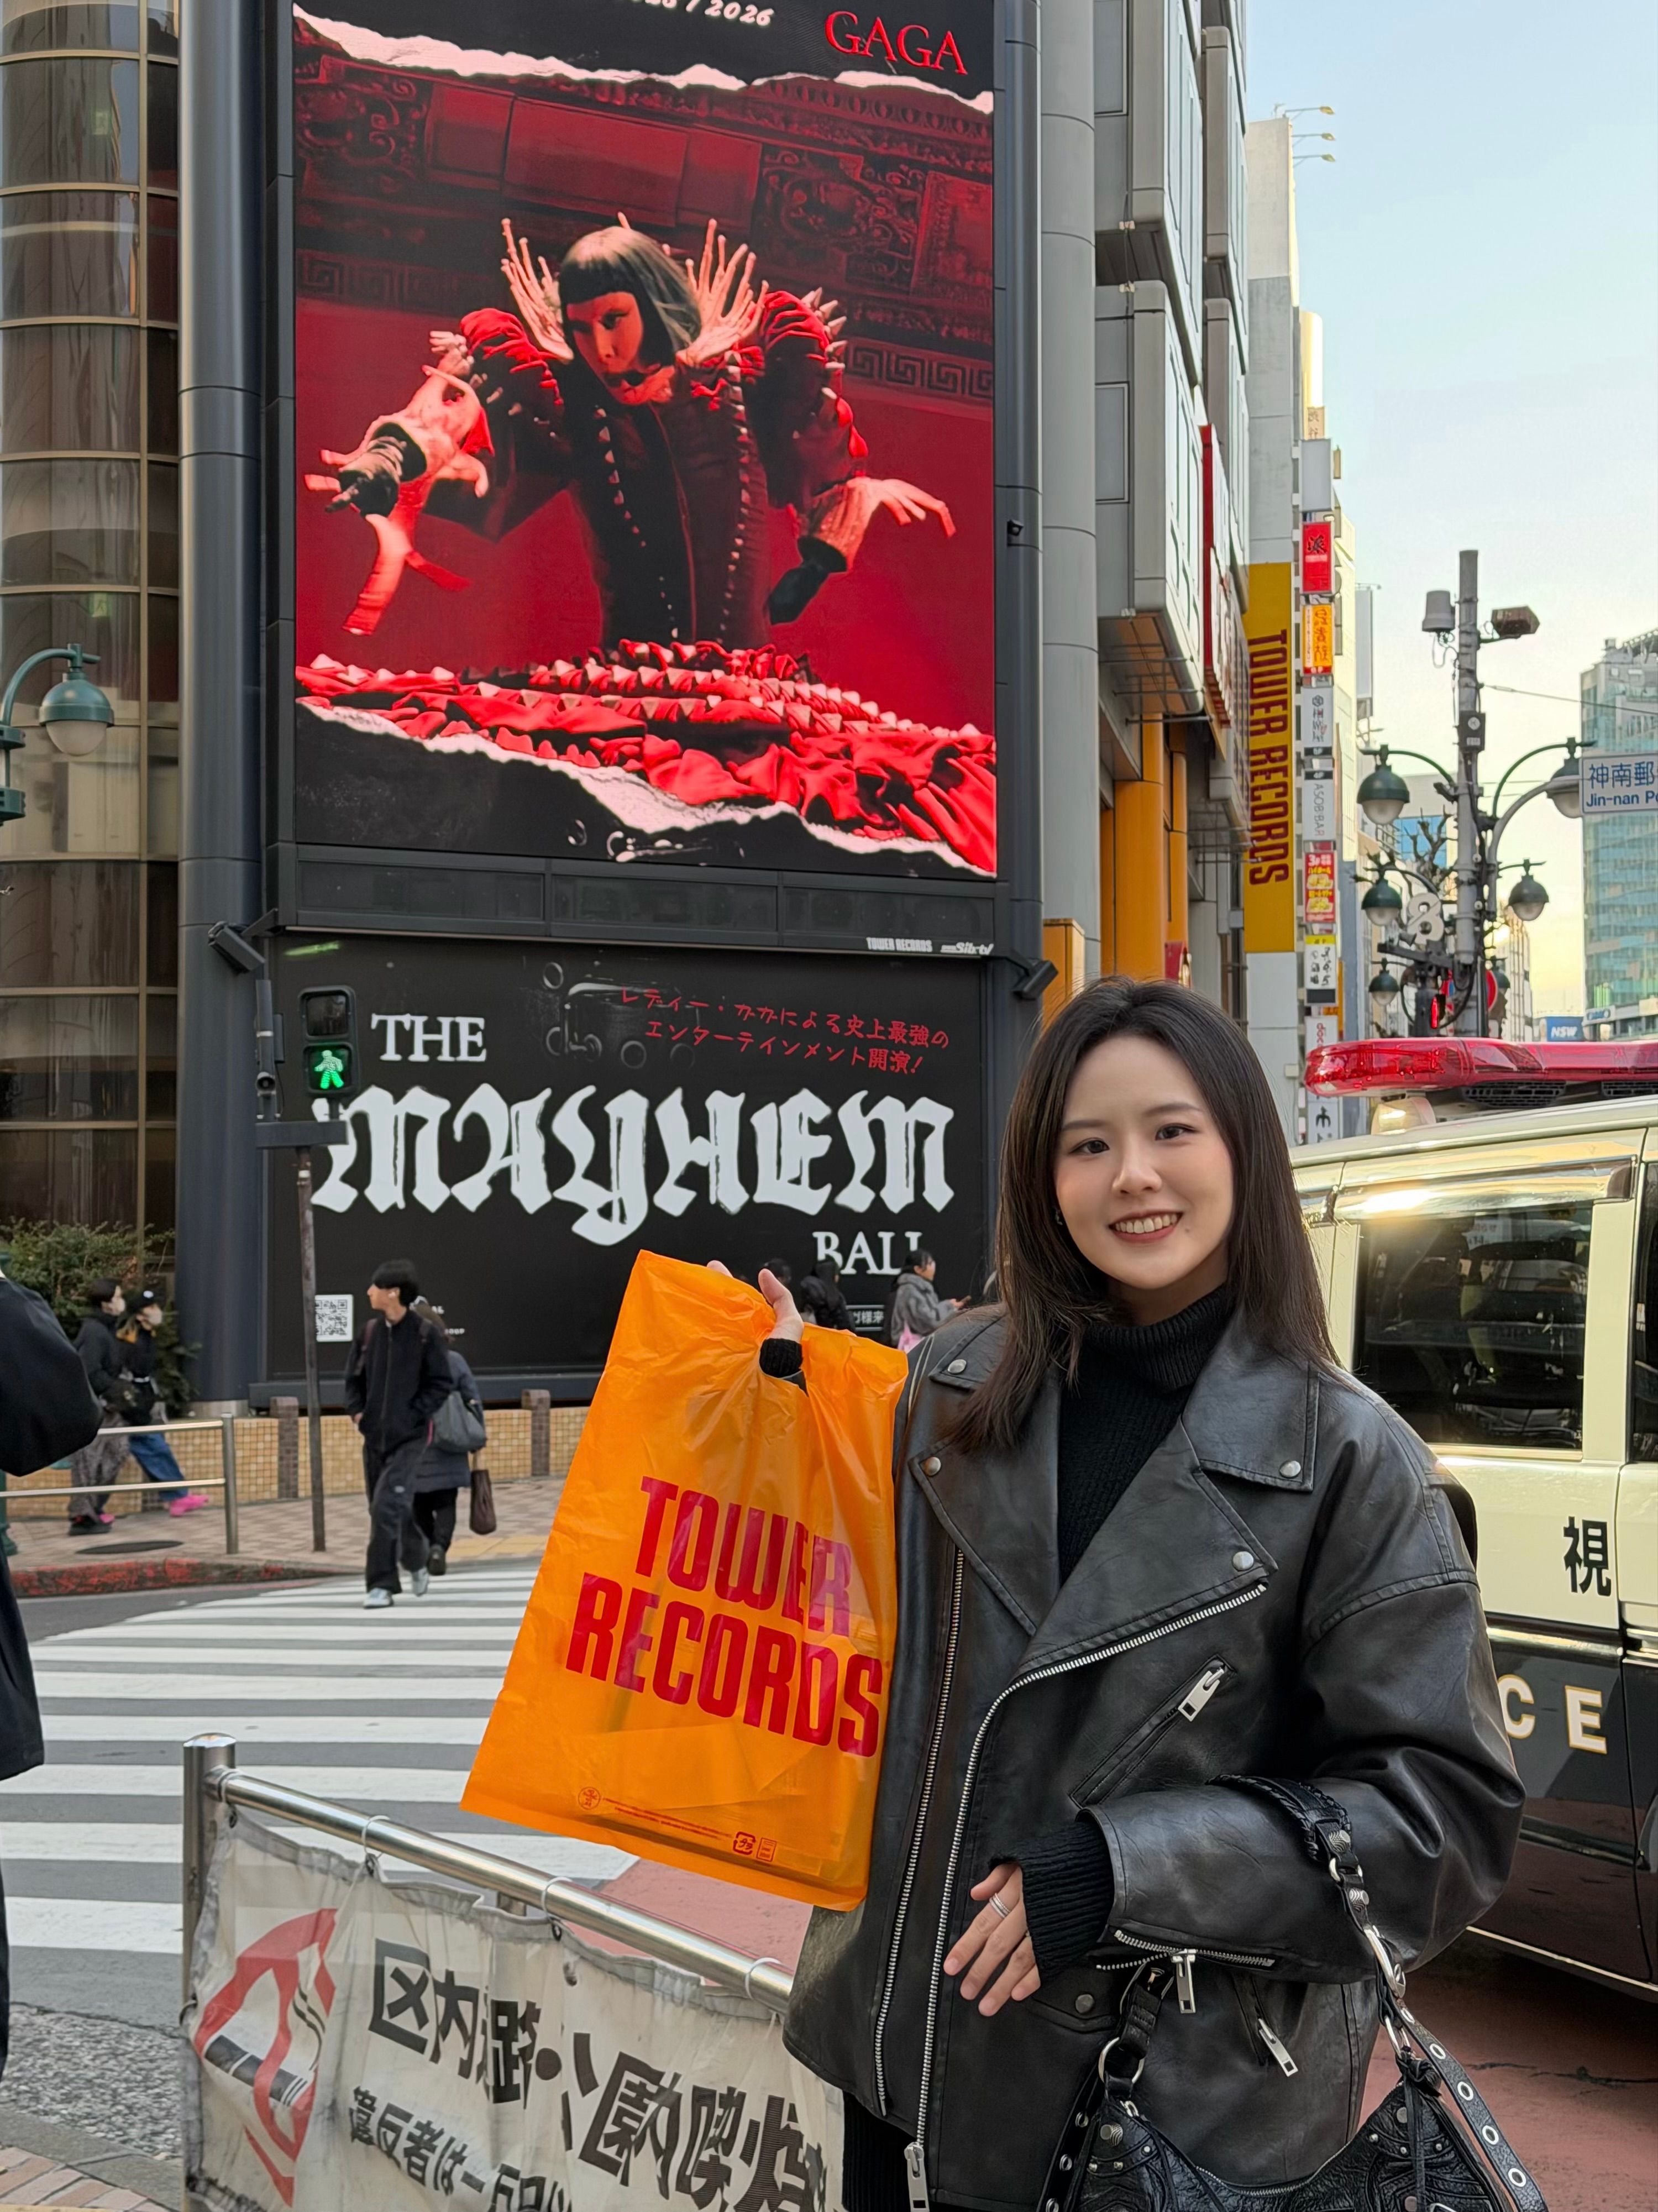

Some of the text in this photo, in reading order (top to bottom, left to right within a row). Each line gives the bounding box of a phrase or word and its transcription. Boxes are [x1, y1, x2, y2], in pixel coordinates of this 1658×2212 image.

[825, 11, 968, 75] GAGA
[1247, 628, 1289, 885] TOWER RECORDS
[1589, 761, 1658, 789] 神南郵
[1586, 793, 1640, 807] Jin-nan
[371, 1013, 487, 1062] THE
[311, 1082, 954, 1245] MAYHEM
[636, 1476, 852, 1637] TOWER
[1563, 1516, 1611, 1596] 視
[565, 1572, 883, 1758] RECORDS
